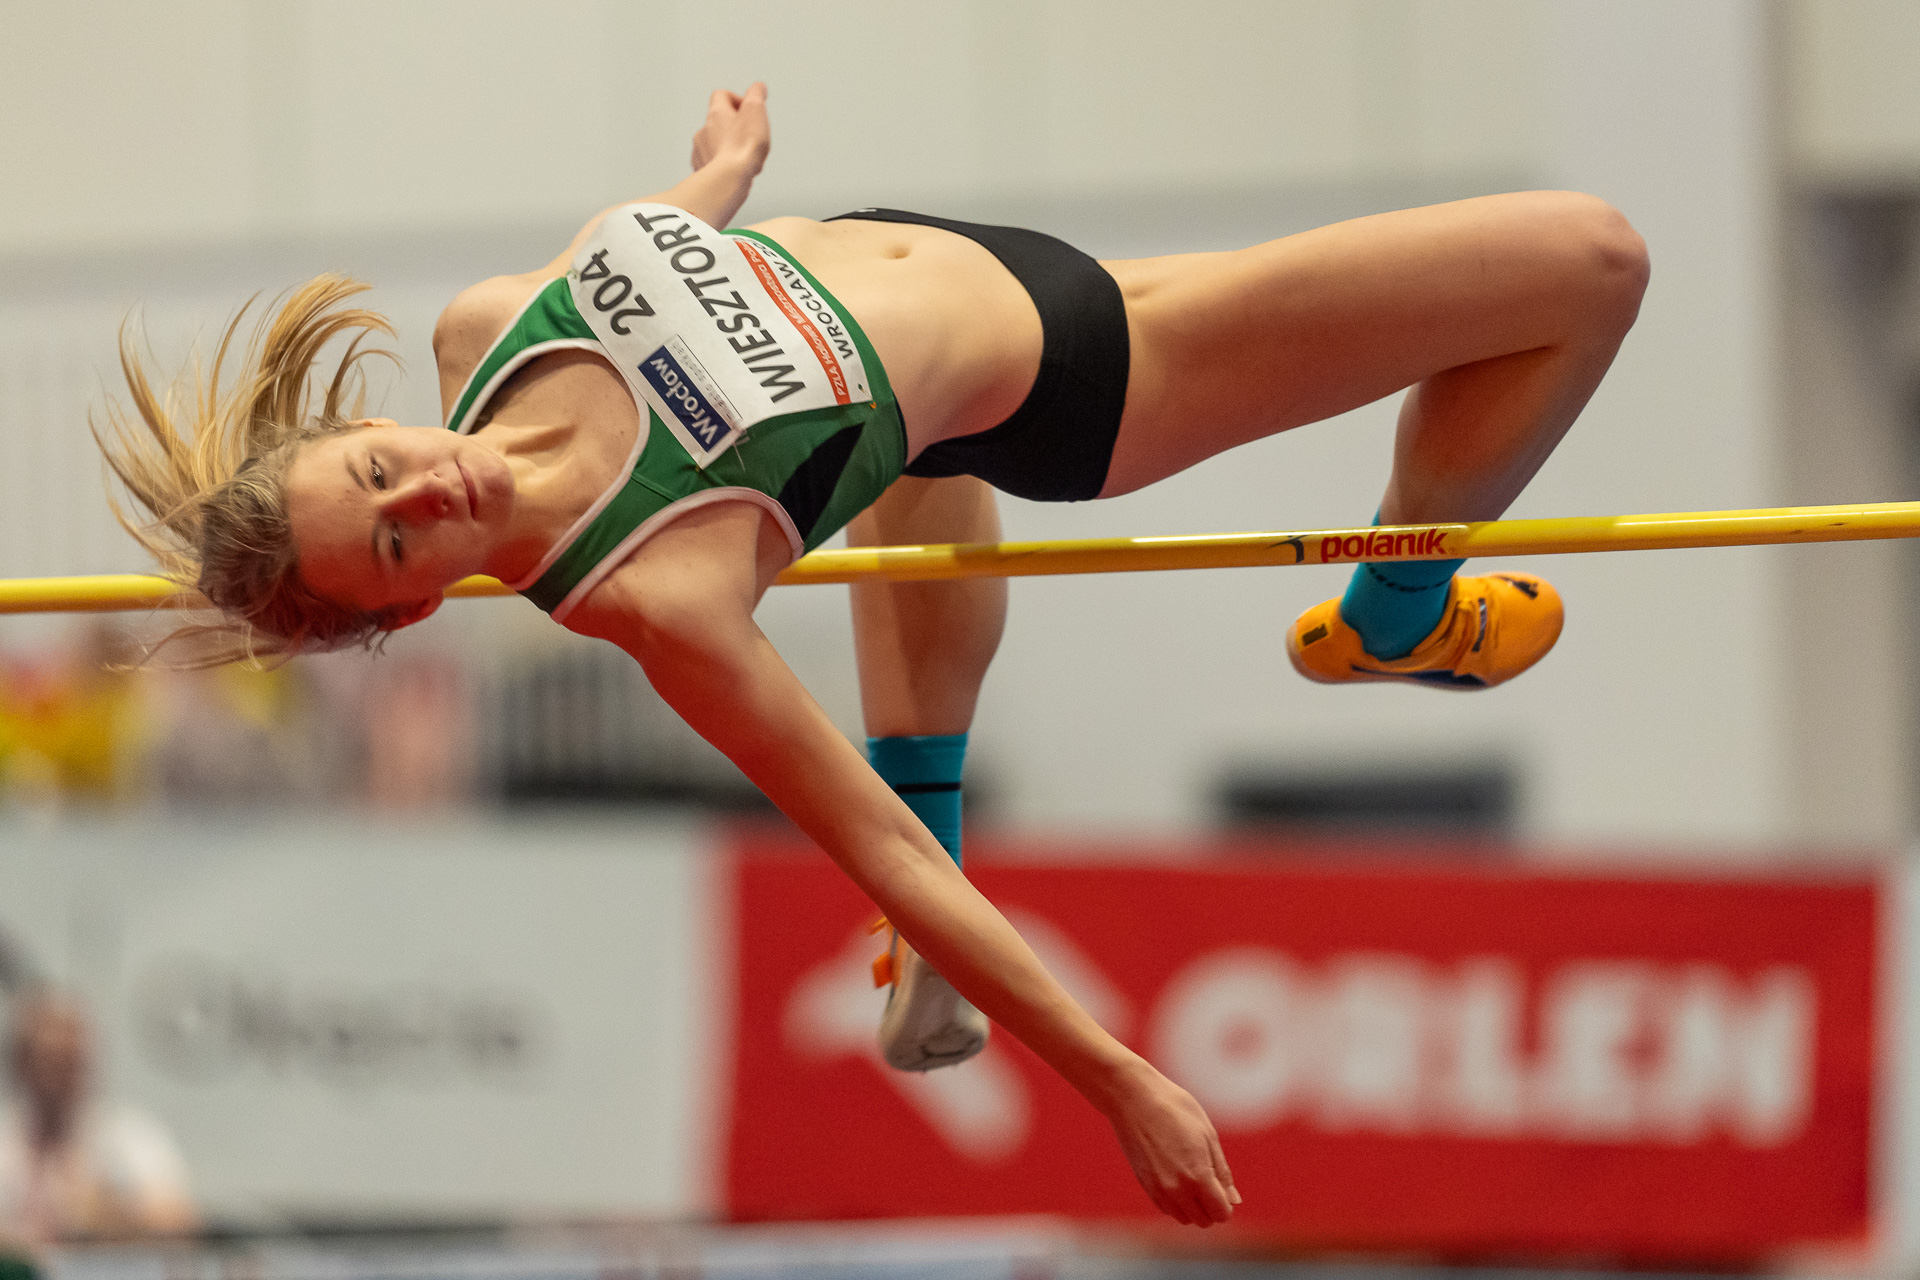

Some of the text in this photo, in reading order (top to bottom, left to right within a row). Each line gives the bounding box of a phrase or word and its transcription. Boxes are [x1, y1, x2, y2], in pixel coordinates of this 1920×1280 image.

[579, 248, 657, 336] 204
[633, 211, 807, 404] WIESZTORT
[773, 260, 855, 360] WROCŁAW
[649, 357, 719, 445] Wrocław
[829, 365, 846, 396] PZLA
[1320, 528, 1449, 563] polanik
